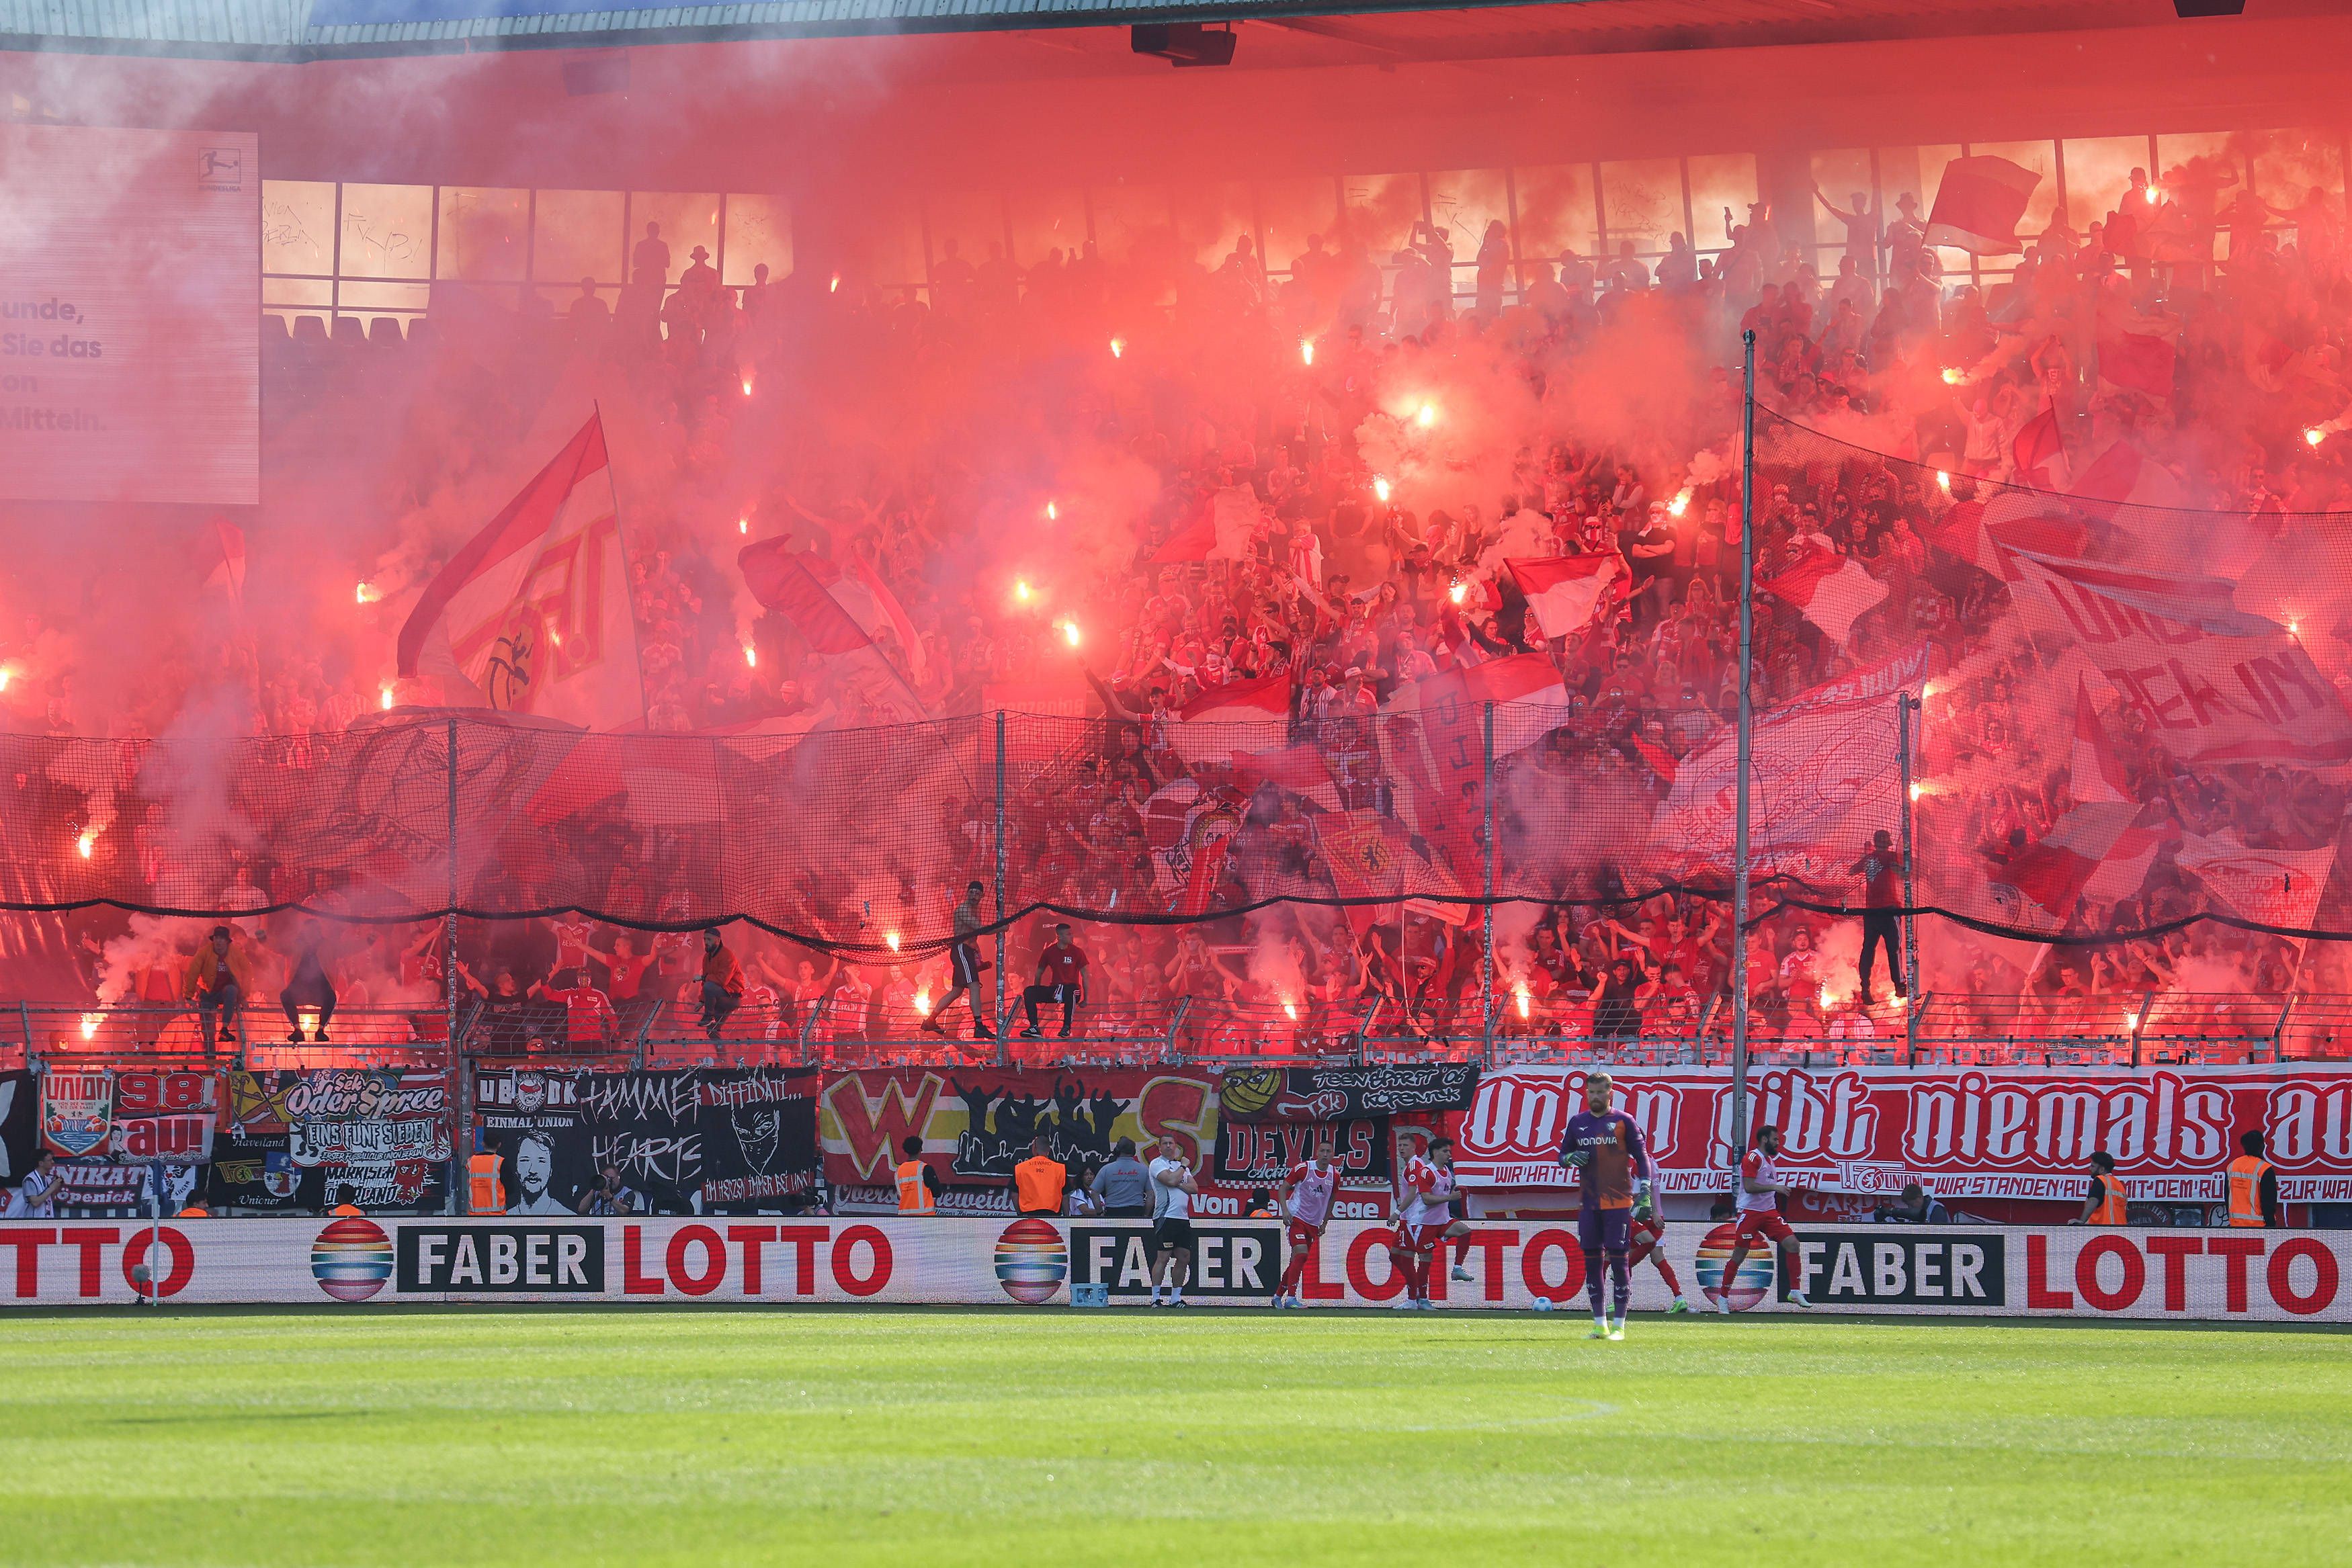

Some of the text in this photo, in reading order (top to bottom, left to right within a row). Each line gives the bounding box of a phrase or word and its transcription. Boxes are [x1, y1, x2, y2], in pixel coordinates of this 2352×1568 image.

[2, 333, 102, 357] Sie das
[46, 1076, 112, 1100] UNION
[119, 1073, 204, 1109] 98
[285, 1079, 446, 1120] Oder Spree
[307, 1119, 434, 1149] EINS FÜNF SIEBEN
[486, 1115, 573, 1129] EINMAL UNION
[823, 1072, 945, 1180] W
[1910, 1075, 2226, 1160] niemals
[1578, 1137, 1618, 1147] VONOVIA
[55, 1188, 136, 1205] öpenick
[1191, 1193, 1238, 1215] Von
[418, 1225, 892, 1296] FABER LOTTO
[1089, 1236, 1263, 1289] FAER
[1800, 1234, 2339, 1314] FABER LOTTO
